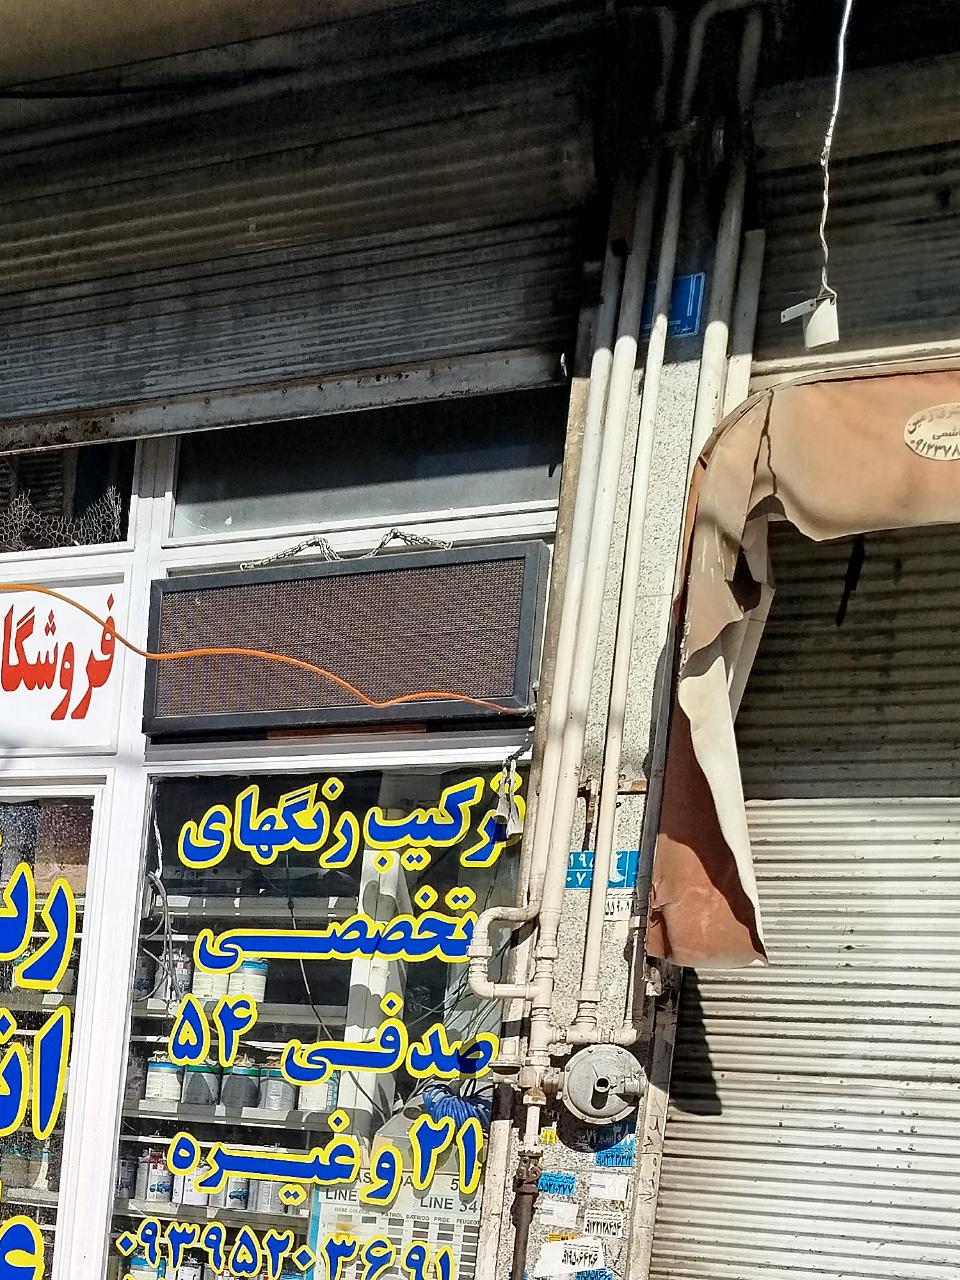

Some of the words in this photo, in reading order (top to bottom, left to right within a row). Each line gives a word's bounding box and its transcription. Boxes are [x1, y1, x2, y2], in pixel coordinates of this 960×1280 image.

[178, 777, 360, 869] رنگهای
[193, 884, 480, 974] تخصصی
[169, 993, 258, 1067] ۵۴
[281, 992, 499, 1085] صدفی
[167, 1109, 361, 1206] غیره
[325, 1188, 357, 1202] LINE
[360, 1145, 404, 1209] و
[408, 1114, 487, 1195] ۲۱
[420, 1197, 453, 1209] LINE
[460, 1200, 477, 1213] 54
